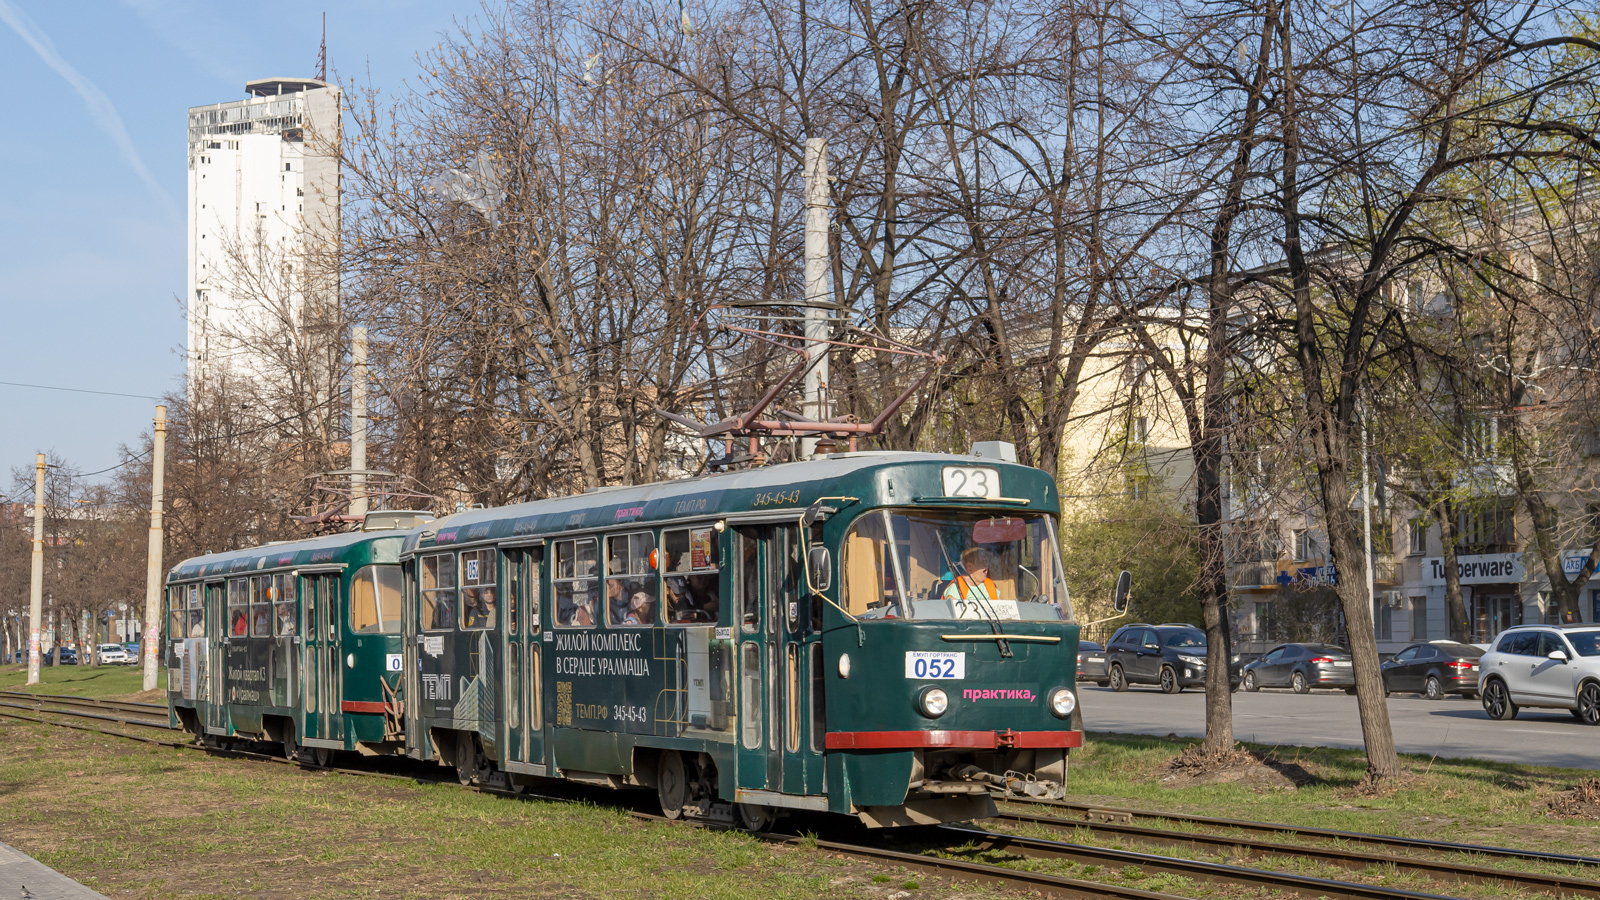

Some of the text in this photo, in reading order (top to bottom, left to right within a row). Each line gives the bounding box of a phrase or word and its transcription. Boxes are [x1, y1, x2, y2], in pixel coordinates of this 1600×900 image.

[951, 469, 989, 497] 23
[674, 499, 706, 514] ТЕМП.РФ
[753, 490, 801, 507] 345-45-43
[1431, 560, 1513, 579] Tuperware
[1566, 560, 1580, 570] АКБ
[556, 631, 642, 652] ЖИЛОЙ КОМПЛЕКС
[556, 657, 650, 677] В СЕРДЦЕ УРАЛМАША
[914, 658, 955, 678] 052
[422, 674, 451, 700] ТЕМП
[963, 689, 1036, 703] практика,
[576, 703, 647, 723] ТЕМП.РФ 345-45-43
